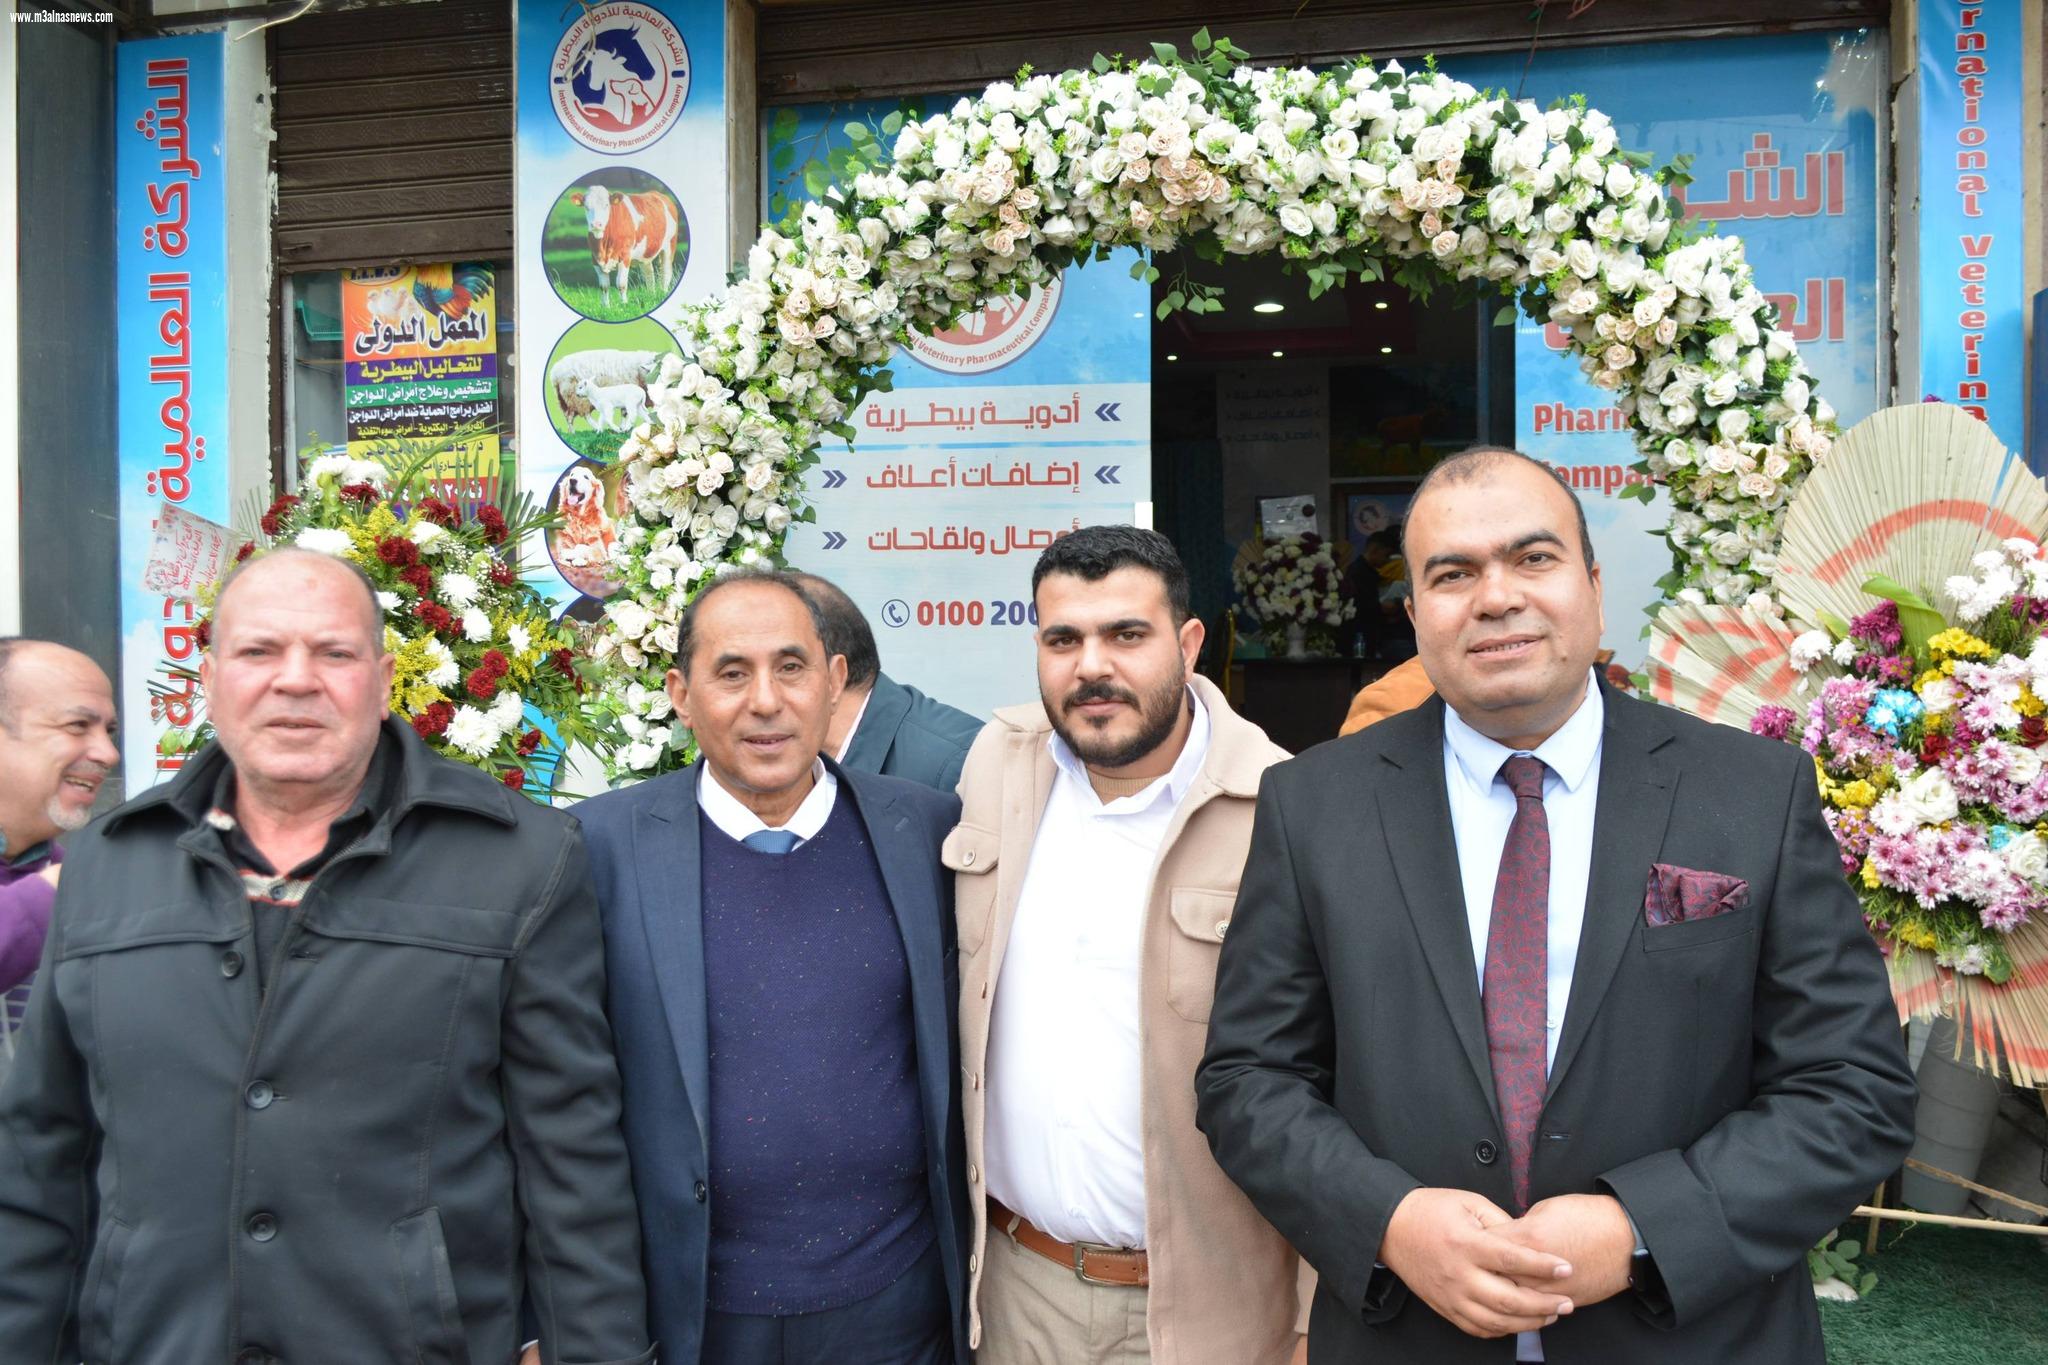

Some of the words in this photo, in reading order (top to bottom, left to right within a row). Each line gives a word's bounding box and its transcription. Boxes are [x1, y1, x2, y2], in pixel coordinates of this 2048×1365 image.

[558, 89, 583, 134] International
[582, 130, 618, 149] Veterinary
[618, 117, 668, 148] Pharmaceutical
[666, 84, 684, 118] Company
[1955, 0, 1988, 217] rnational
[136, 58, 202, 258] الشركة
[429, 311, 487, 348] المعمل
[918, 340, 965, 366] Veterinary
[966, 325, 1034, 364] Pharmaceutical
[360, 360, 422, 384] البيطرية
[423, 356, 483, 378] للتحاليل
[147, 271, 206, 503] العالمية
[350, 388, 387, 405] الدواجن
[418, 384, 449, 400] وعلاج
[449, 380, 492, 399] لتشخيص
[866, 402, 975, 432] بيطرية
[980, 392, 1080, 430] أدوية
[866, 456, 957, 489] أعلاف
[961, 461, 1080, 493] إضافات
[868, 525, 986, 556] ولقاحات
[916, 600, 985, 627] 0100
